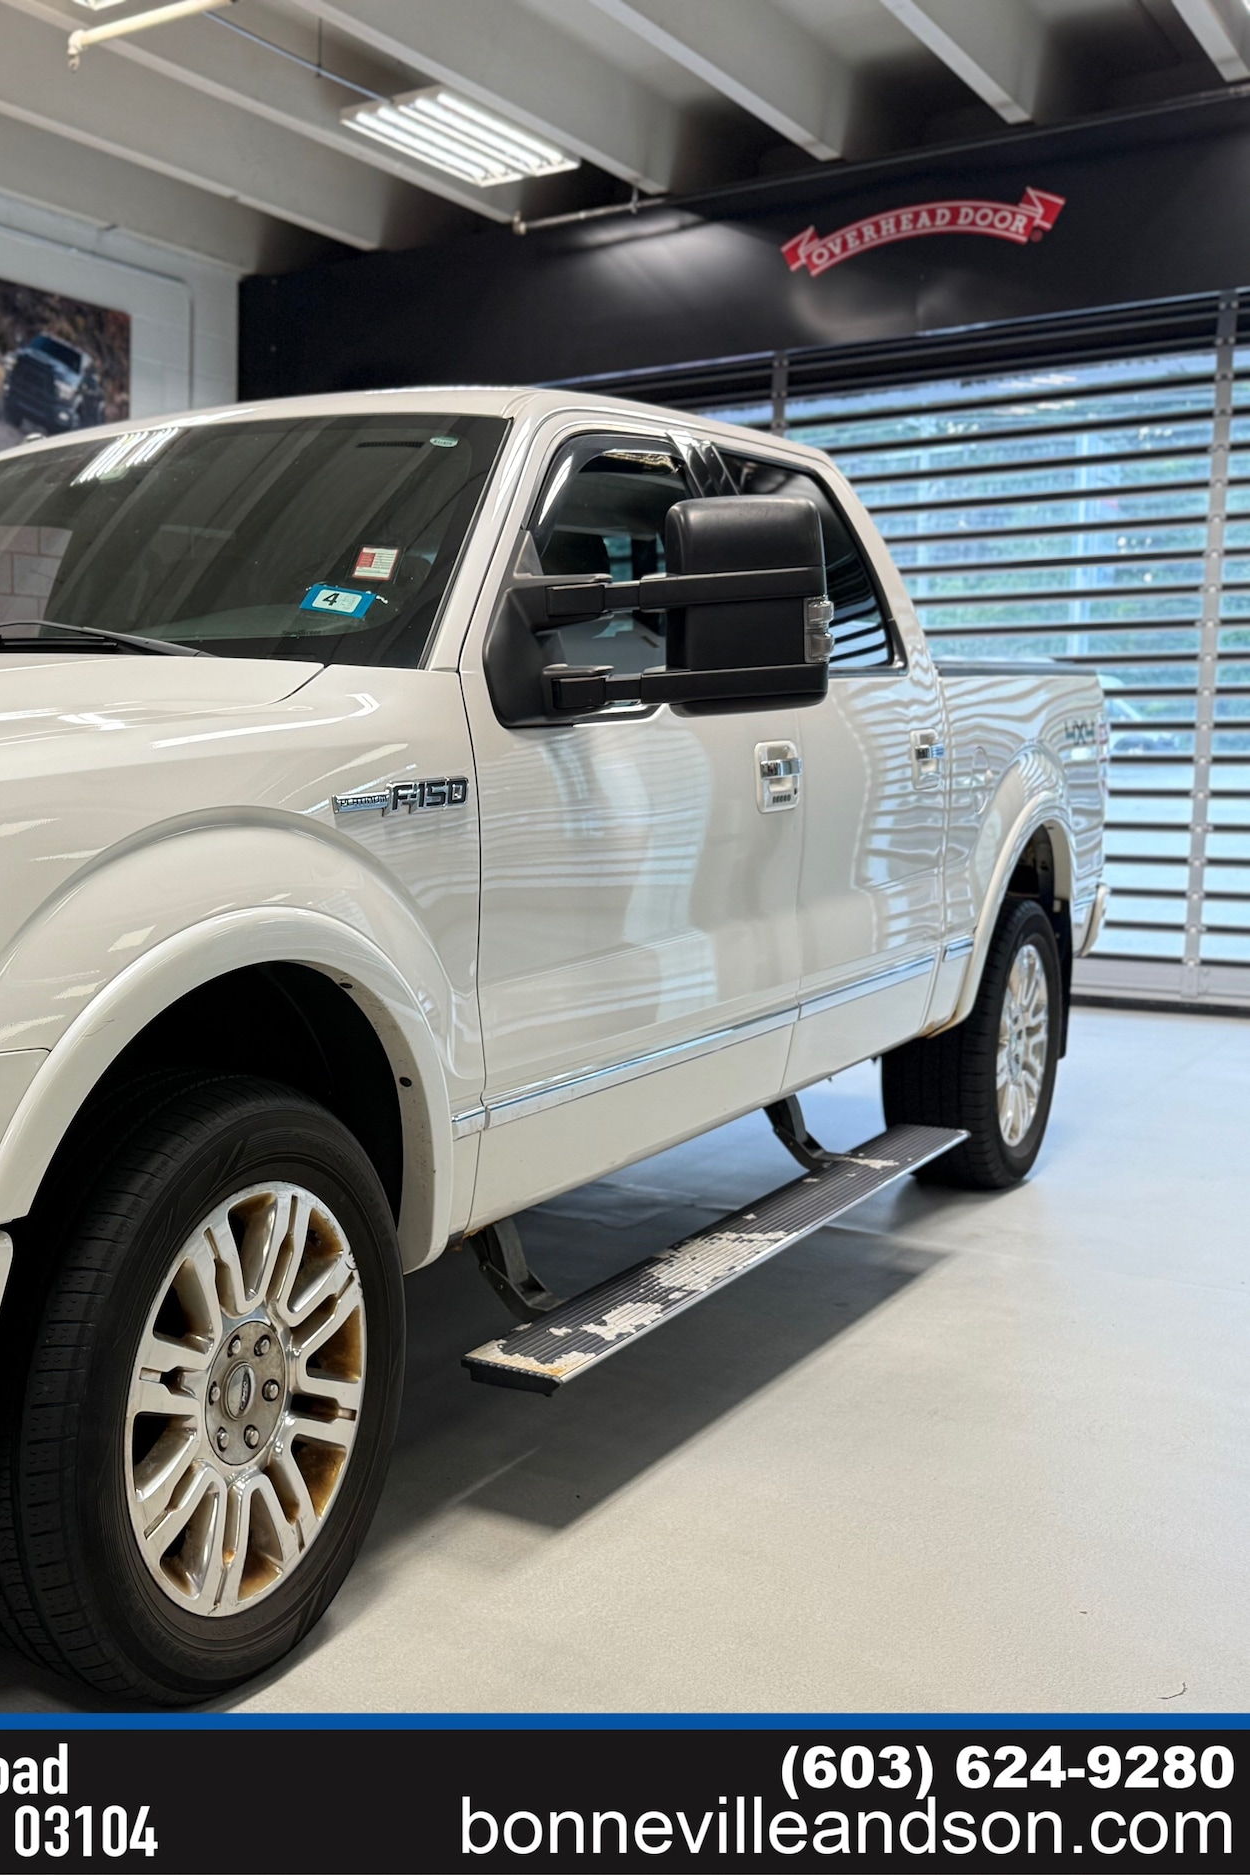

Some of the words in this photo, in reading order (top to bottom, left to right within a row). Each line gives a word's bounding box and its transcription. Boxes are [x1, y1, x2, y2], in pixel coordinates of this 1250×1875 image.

[811, 207, 952, 266] OVERHEAD
[956, 207, 1028, 234] DOOR
[322, 592, 340, 606] 4
